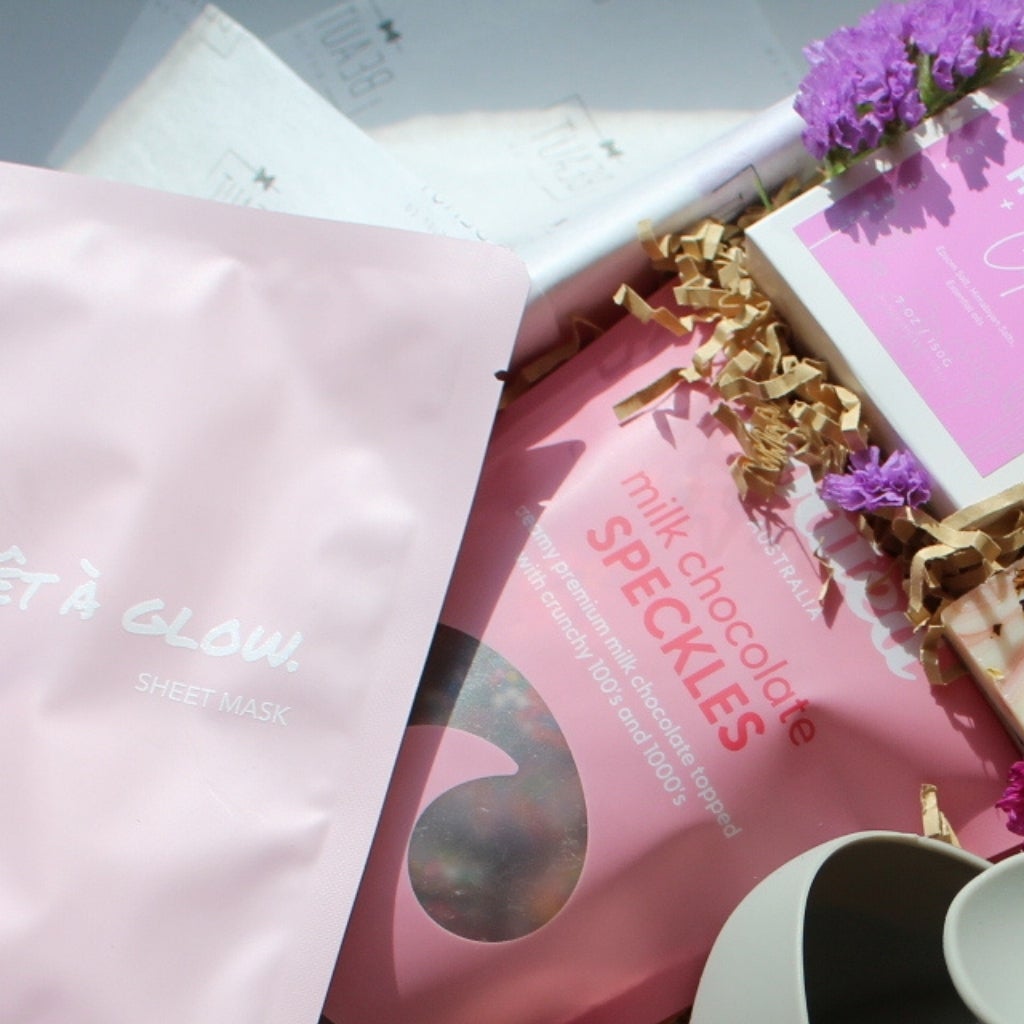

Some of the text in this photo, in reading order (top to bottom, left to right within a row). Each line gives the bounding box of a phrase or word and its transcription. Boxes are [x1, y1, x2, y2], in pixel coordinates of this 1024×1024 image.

[59, 558, 101, 620] À
[518, 552, 687, 806] with crunchy 100's and 1000's
[587, 516, 765, 751] SPECKLES
[621, 470, 815, 746] milk chocolate
[747, 519, 822, 621] AUSTRALIA
[135, 672, 291, 725] SHEET MASK
[551, 560, 611, 637] premium
[604, 635, 637, 675] milk
[631, 675, 695, 767] chocolate
[690, 766, 742, 839] topped
